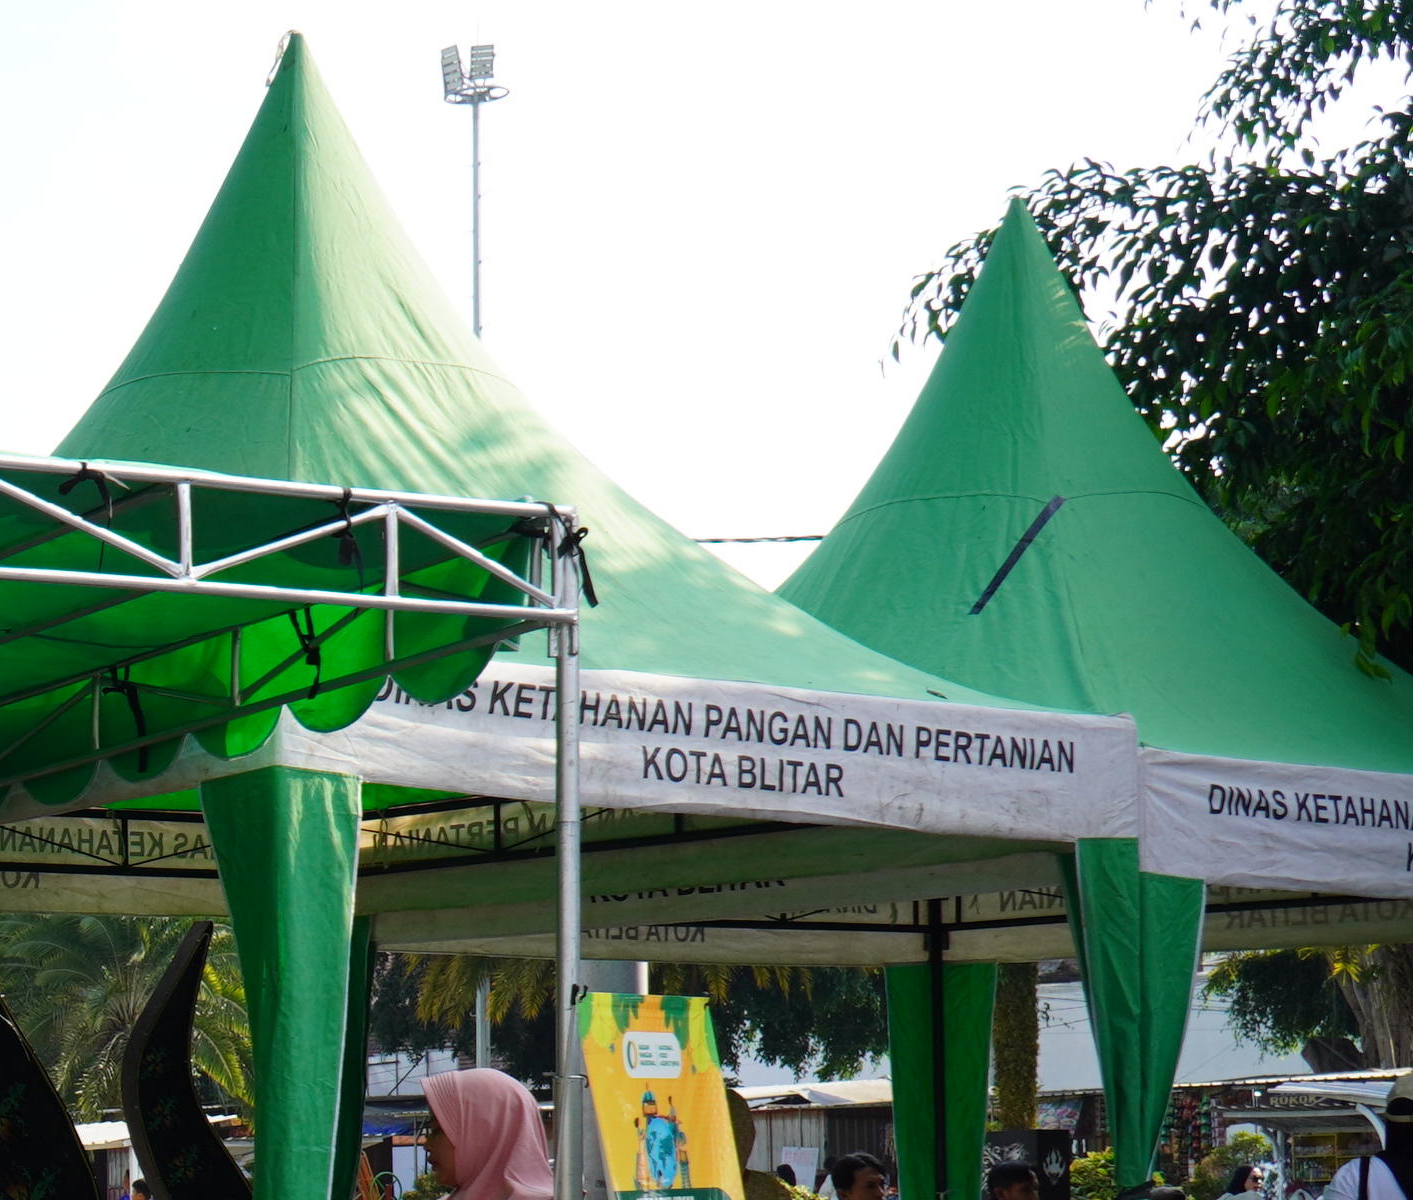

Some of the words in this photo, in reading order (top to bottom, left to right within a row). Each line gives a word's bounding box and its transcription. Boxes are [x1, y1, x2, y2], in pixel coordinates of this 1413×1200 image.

[488, 681, 693, 736] KETHANAN
[704, 704, 832, 749] PANGAN
[843, 717, 904, 757] DAN
[914, 726, 1075, 773] PERTANIAN
[642, 745, 728, 787] KOTA
[737, 755, 844, 798] BLITAR
[1208, 783, 1289, 820] DINAS
[1294, 792, 1413, 830] KETAHAN
